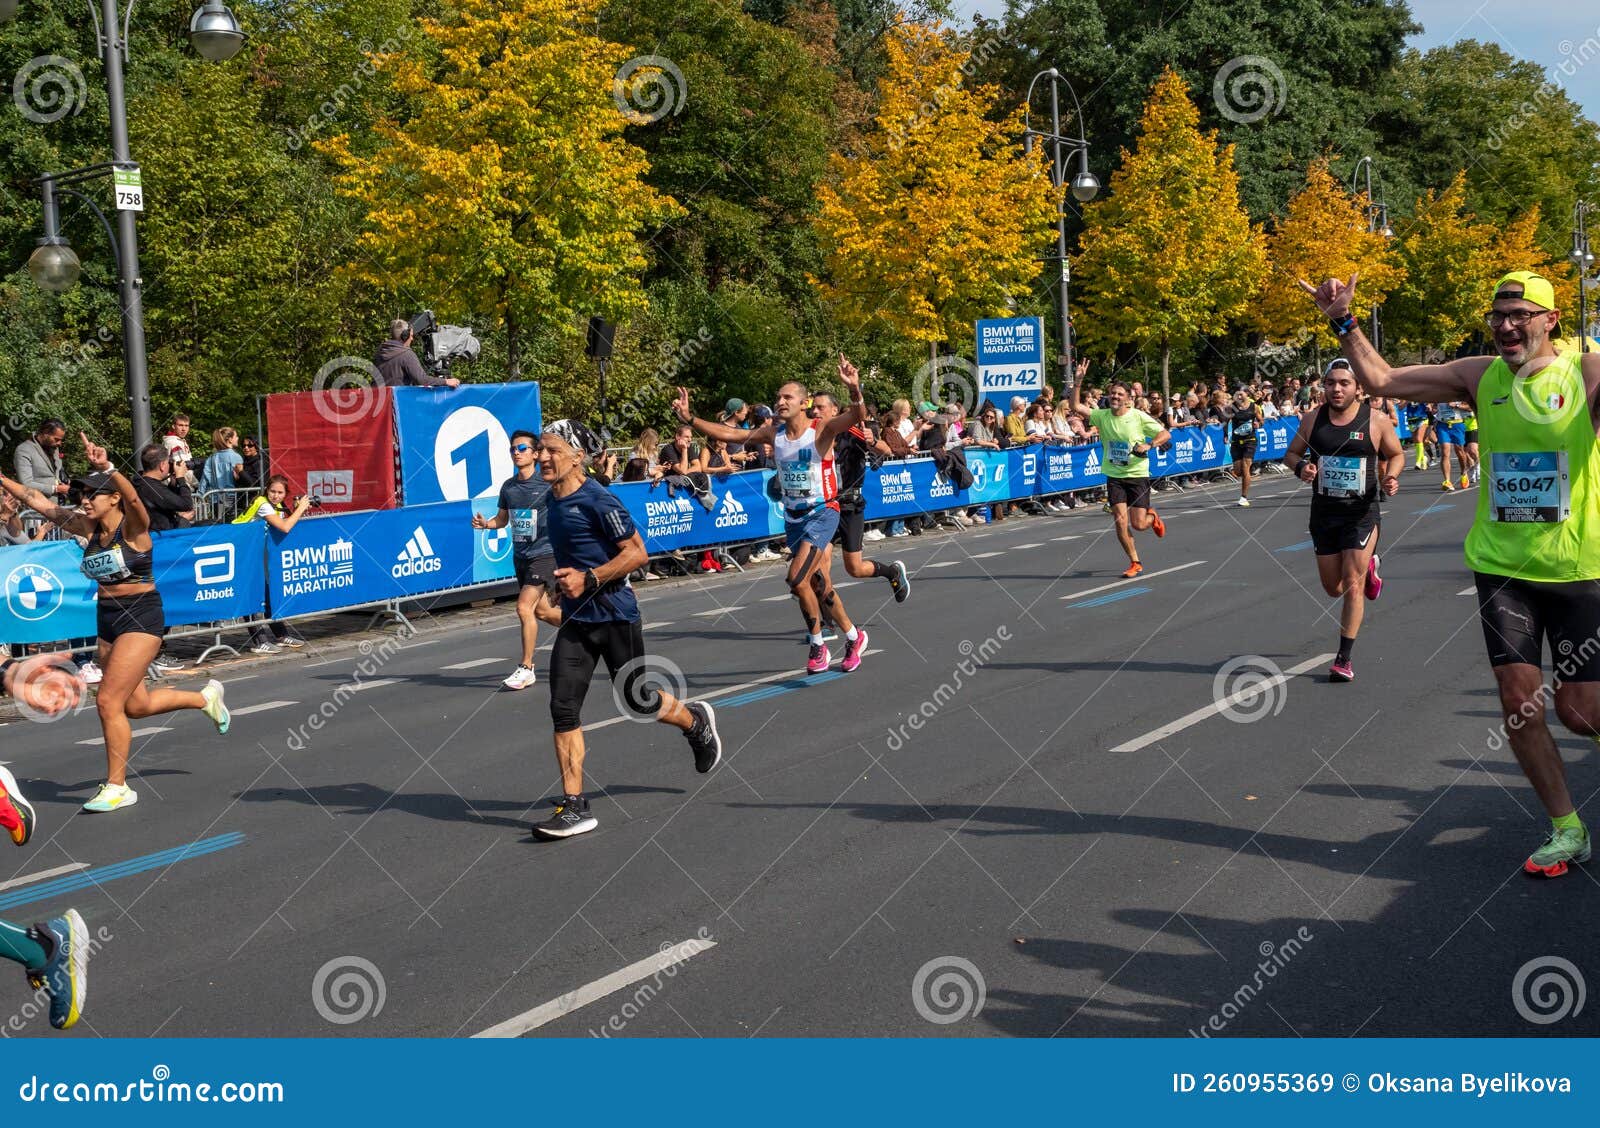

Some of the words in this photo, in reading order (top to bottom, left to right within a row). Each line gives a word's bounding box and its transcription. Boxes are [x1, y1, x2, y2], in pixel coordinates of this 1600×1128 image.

[118, 192, 141, 205] 758
[983, 326, 1014, 338] BMW
[983, 337, 1015, 346] BERLIN
[983, 344, 1035, 354] MARATHON
[982, 369, 1013, 387] km
[1015, 369, 1038, 386] 42
[783, 473, 807, 482] 21263
[880, 474, 900, 487] BMW
[1323, 470, 1357, 481] 52753
[311, 477, 347, 496] rbb
[882, 485, 903, 496] BERLIN
[930, 485, 954, 498] adidas
[1496, 477, 1555, 492] 66047
[1510, 495, 1538, 504] David
[645, 500, 677, 517] BMW
[648, 513, 678, 527] BERLIN
[715, 513, 748, 528] adidas
[647, 523, 692, 538] MARATHON
[82, 554, 113, 570] 70572
[281, 545, 327, 569] BMW
[282, 564, 329, 583] BERLIN
[391, 557, 442, 578] adidas
[283, 574, 354, 597] MARATHON
[194, 586, 235, 601] Abbott
